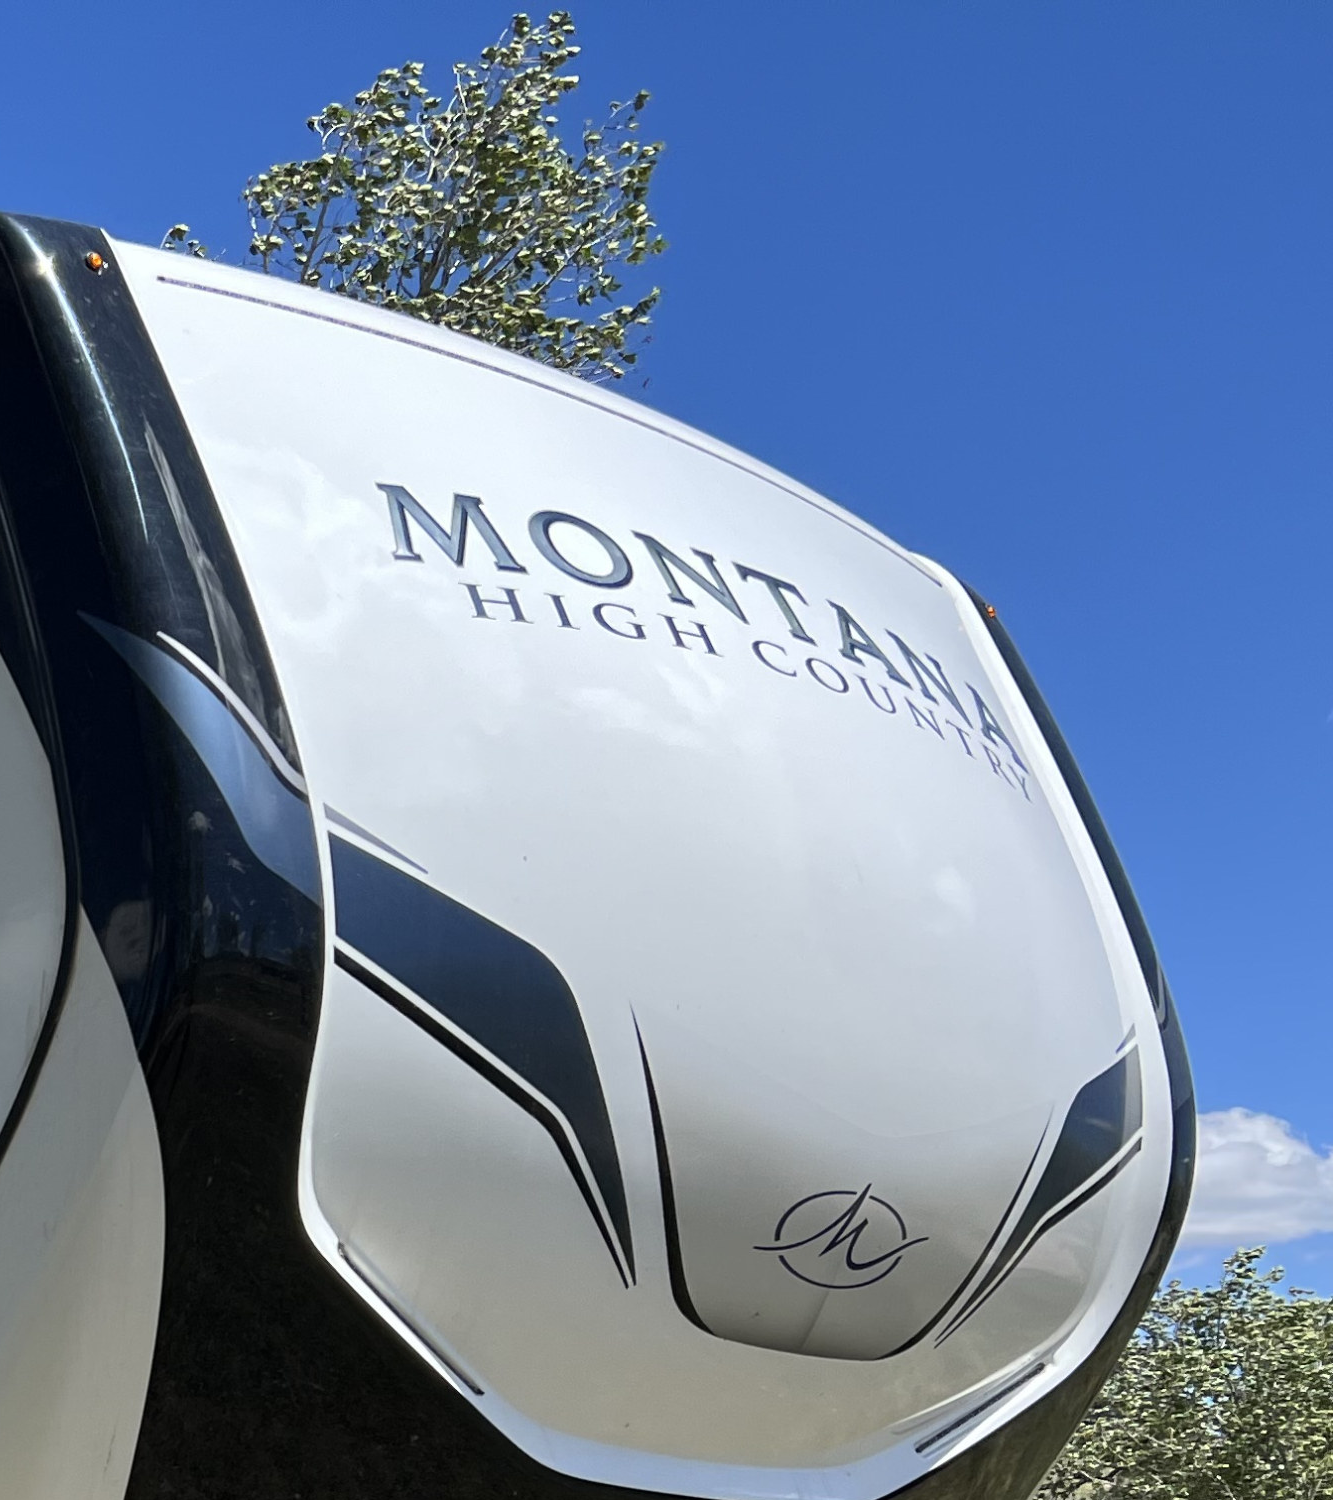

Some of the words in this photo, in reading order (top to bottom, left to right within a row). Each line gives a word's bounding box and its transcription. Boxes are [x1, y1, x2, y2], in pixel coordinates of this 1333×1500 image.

[376, 482, 1030, 774] MONTANA
[458, 581, 724, 657] HIGH
[751, 639, 1034, 803] COUNTRY
